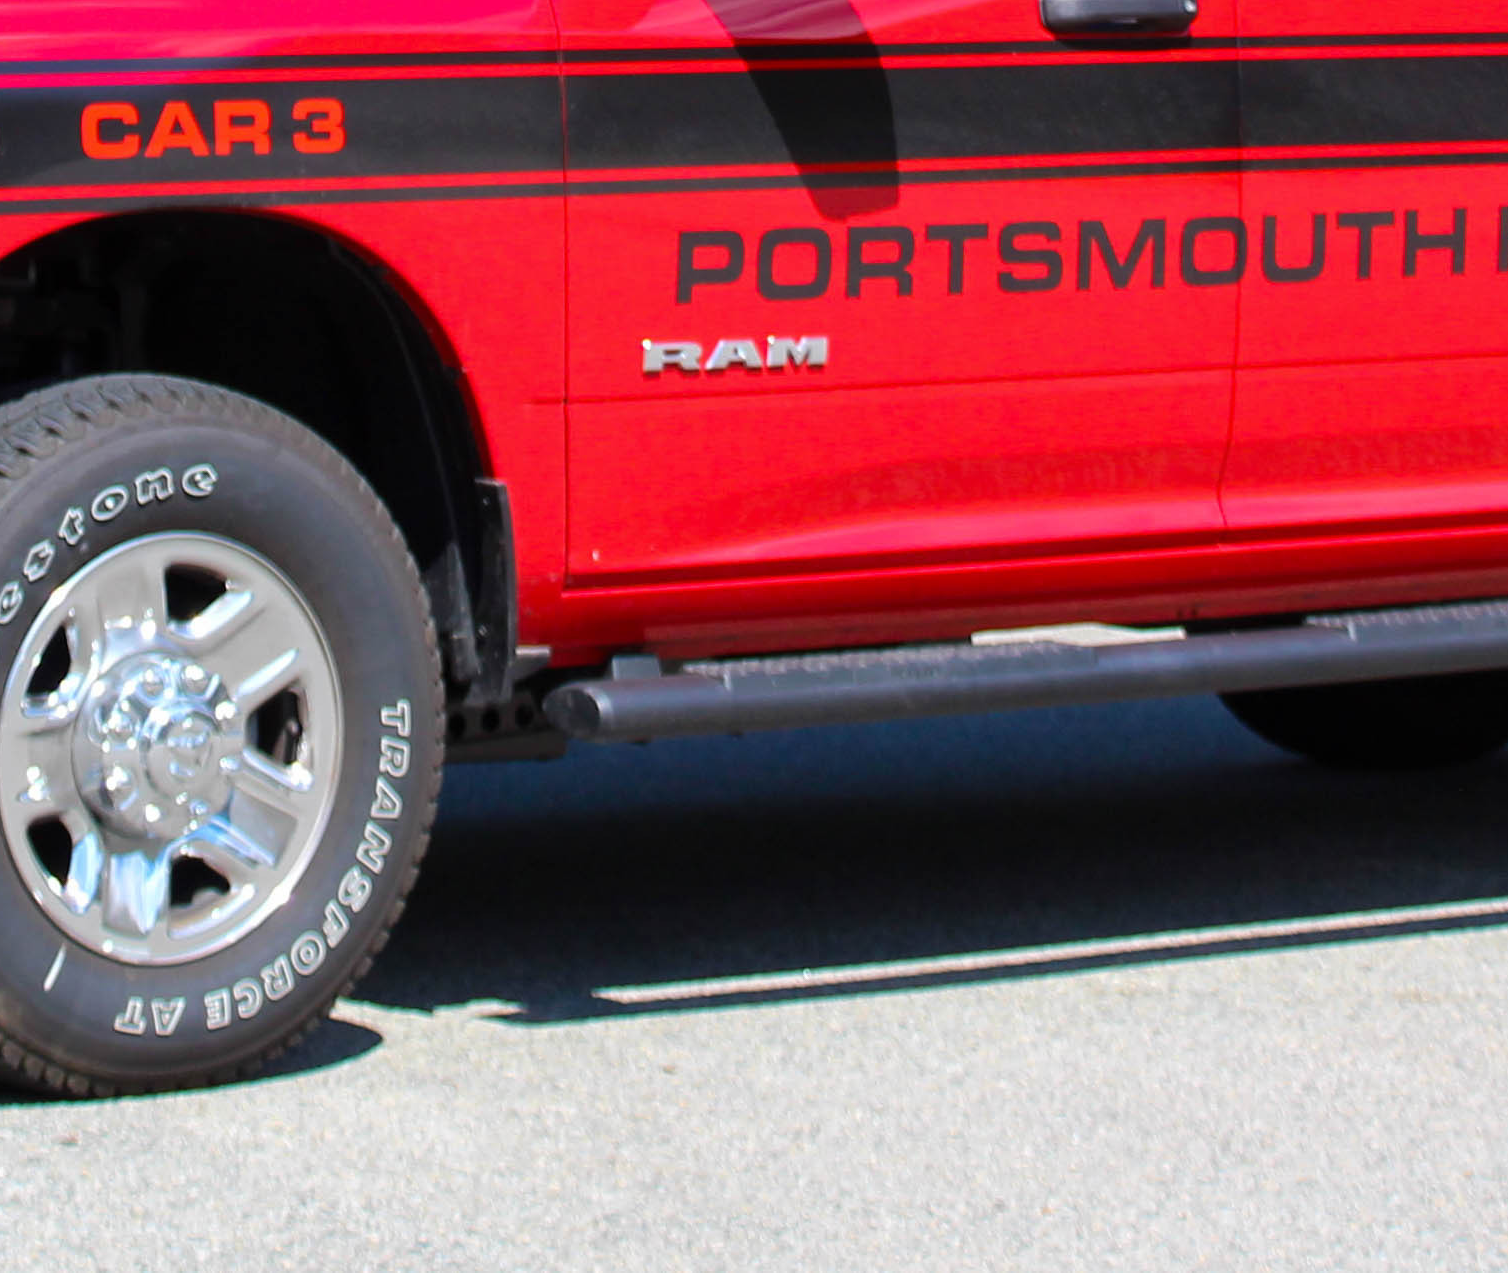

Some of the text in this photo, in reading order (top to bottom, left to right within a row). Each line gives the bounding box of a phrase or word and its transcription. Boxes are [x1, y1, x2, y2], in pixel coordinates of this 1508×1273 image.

[80, 97, 346, 160] CAR 3
[675, 206, 1468, 305] PORTSMOUTH
[640, 333, 830, 374] RAM
[113, 698, 411, 1037] TRANSFORCE AT
